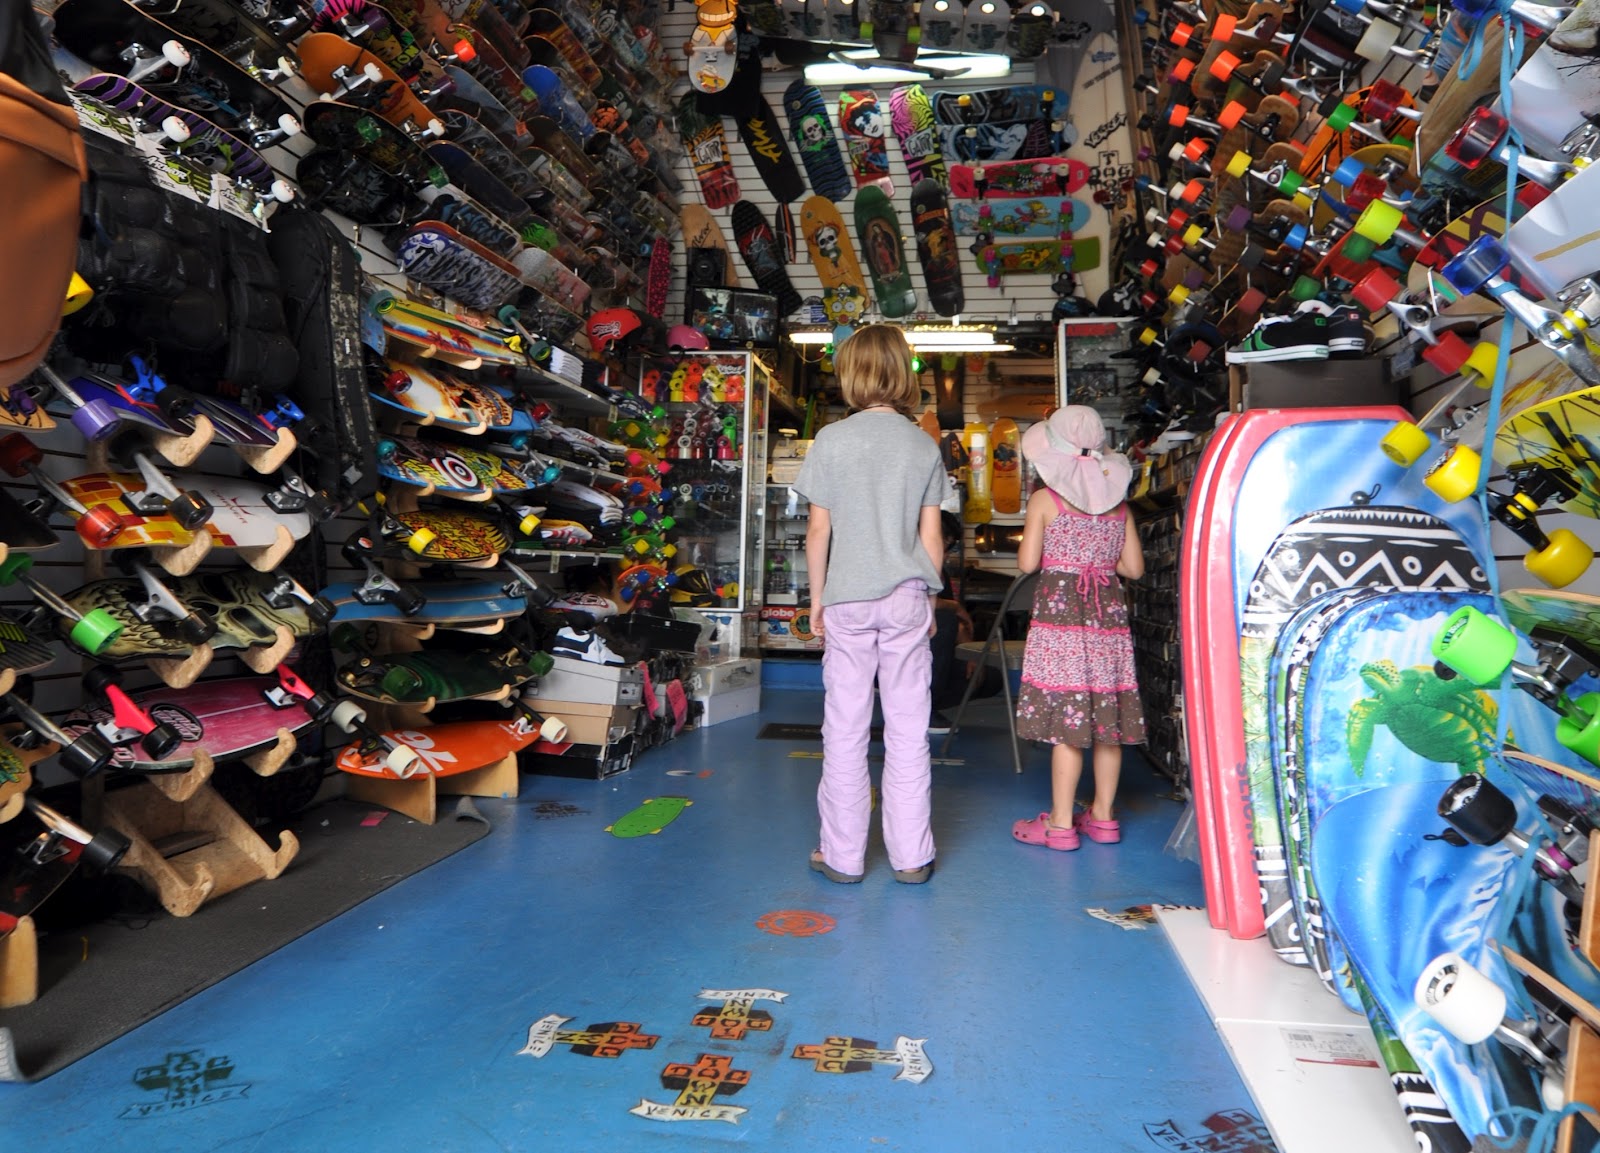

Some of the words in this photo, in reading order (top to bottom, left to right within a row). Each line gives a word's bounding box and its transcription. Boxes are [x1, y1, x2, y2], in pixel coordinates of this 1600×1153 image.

[761, 608, 795, 619] globe
[529, 1020, 558, 1052] VENICE
[139, 1090, 234, 1115] VENICE
[645, 1106, 731, 1119] VENICE
